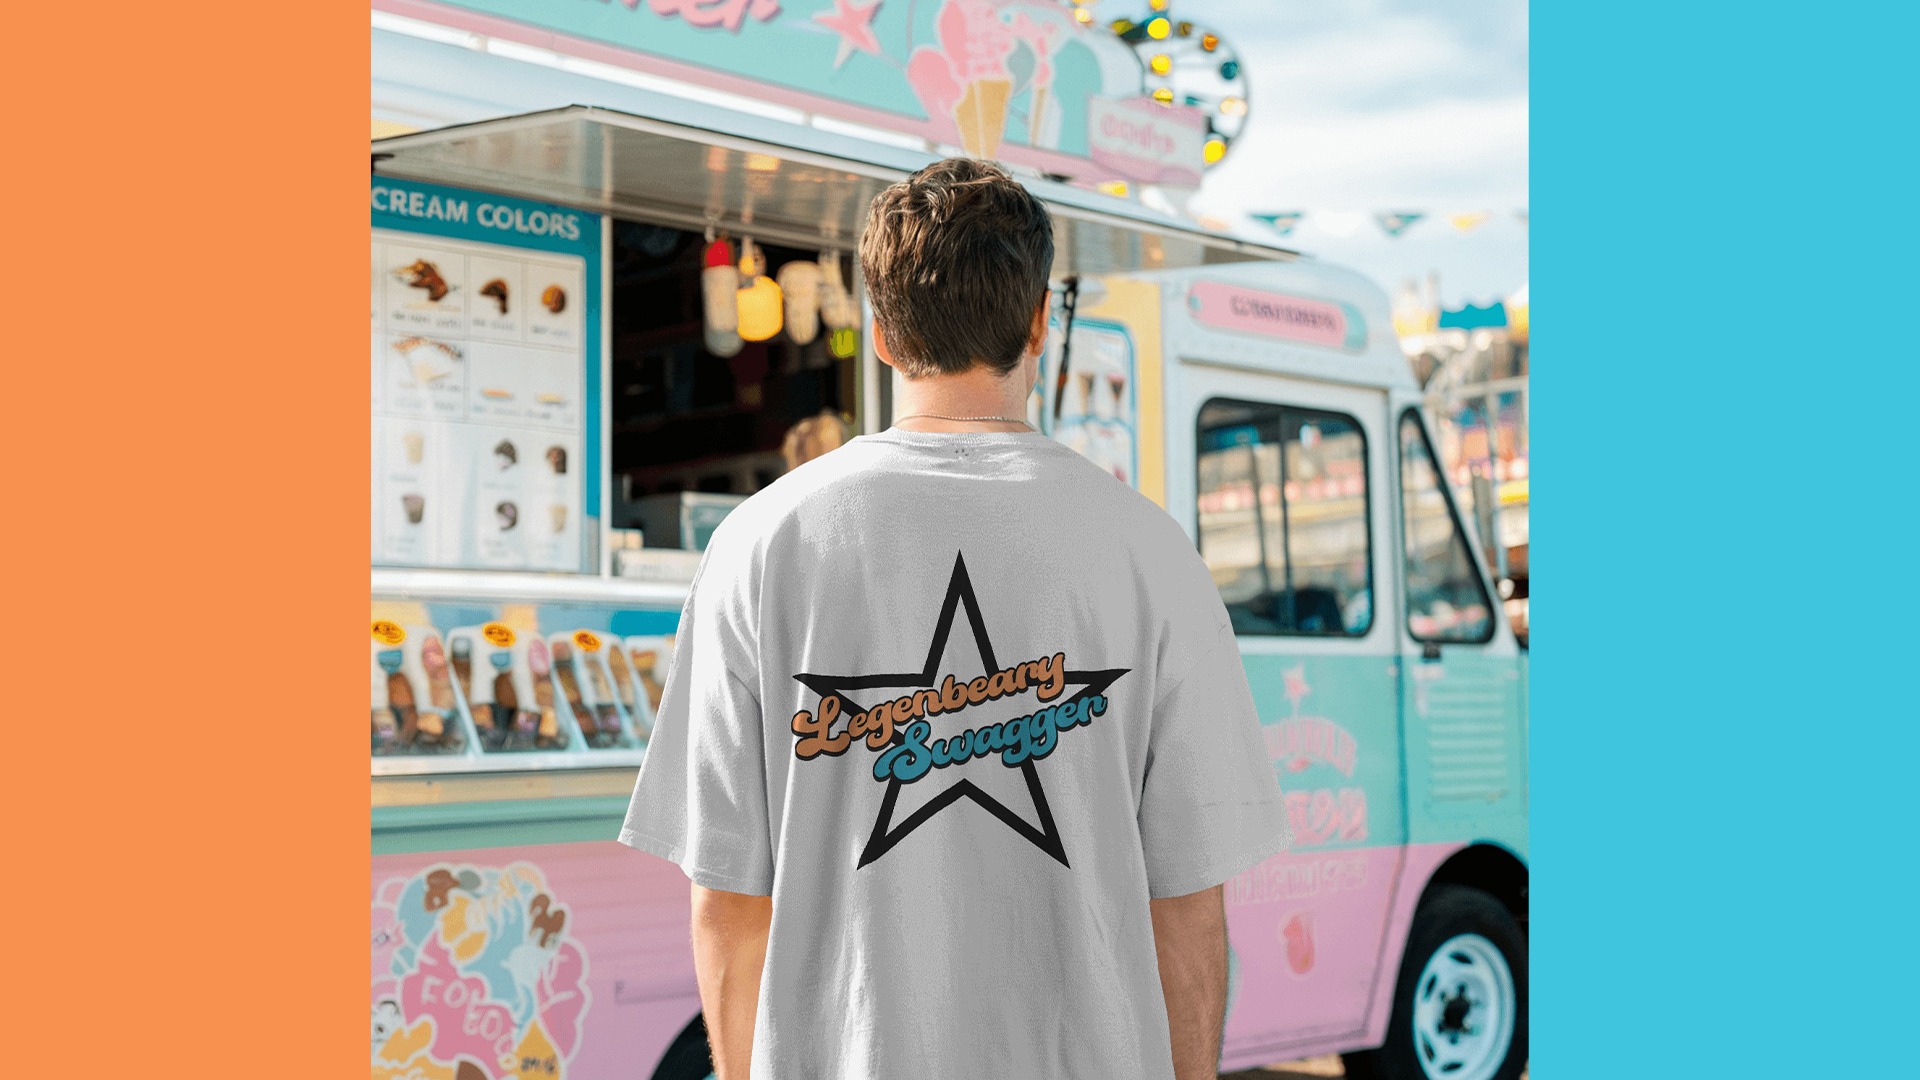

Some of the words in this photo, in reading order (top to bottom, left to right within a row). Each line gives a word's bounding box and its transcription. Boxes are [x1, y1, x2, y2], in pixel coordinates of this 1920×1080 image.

[371, 186, 469, 224] CREAM
[476, 203, 580, 240] COLORS
[791, 652, 1066, 761] Legenbeary
[873, 694, 1109, 785] Swagger
